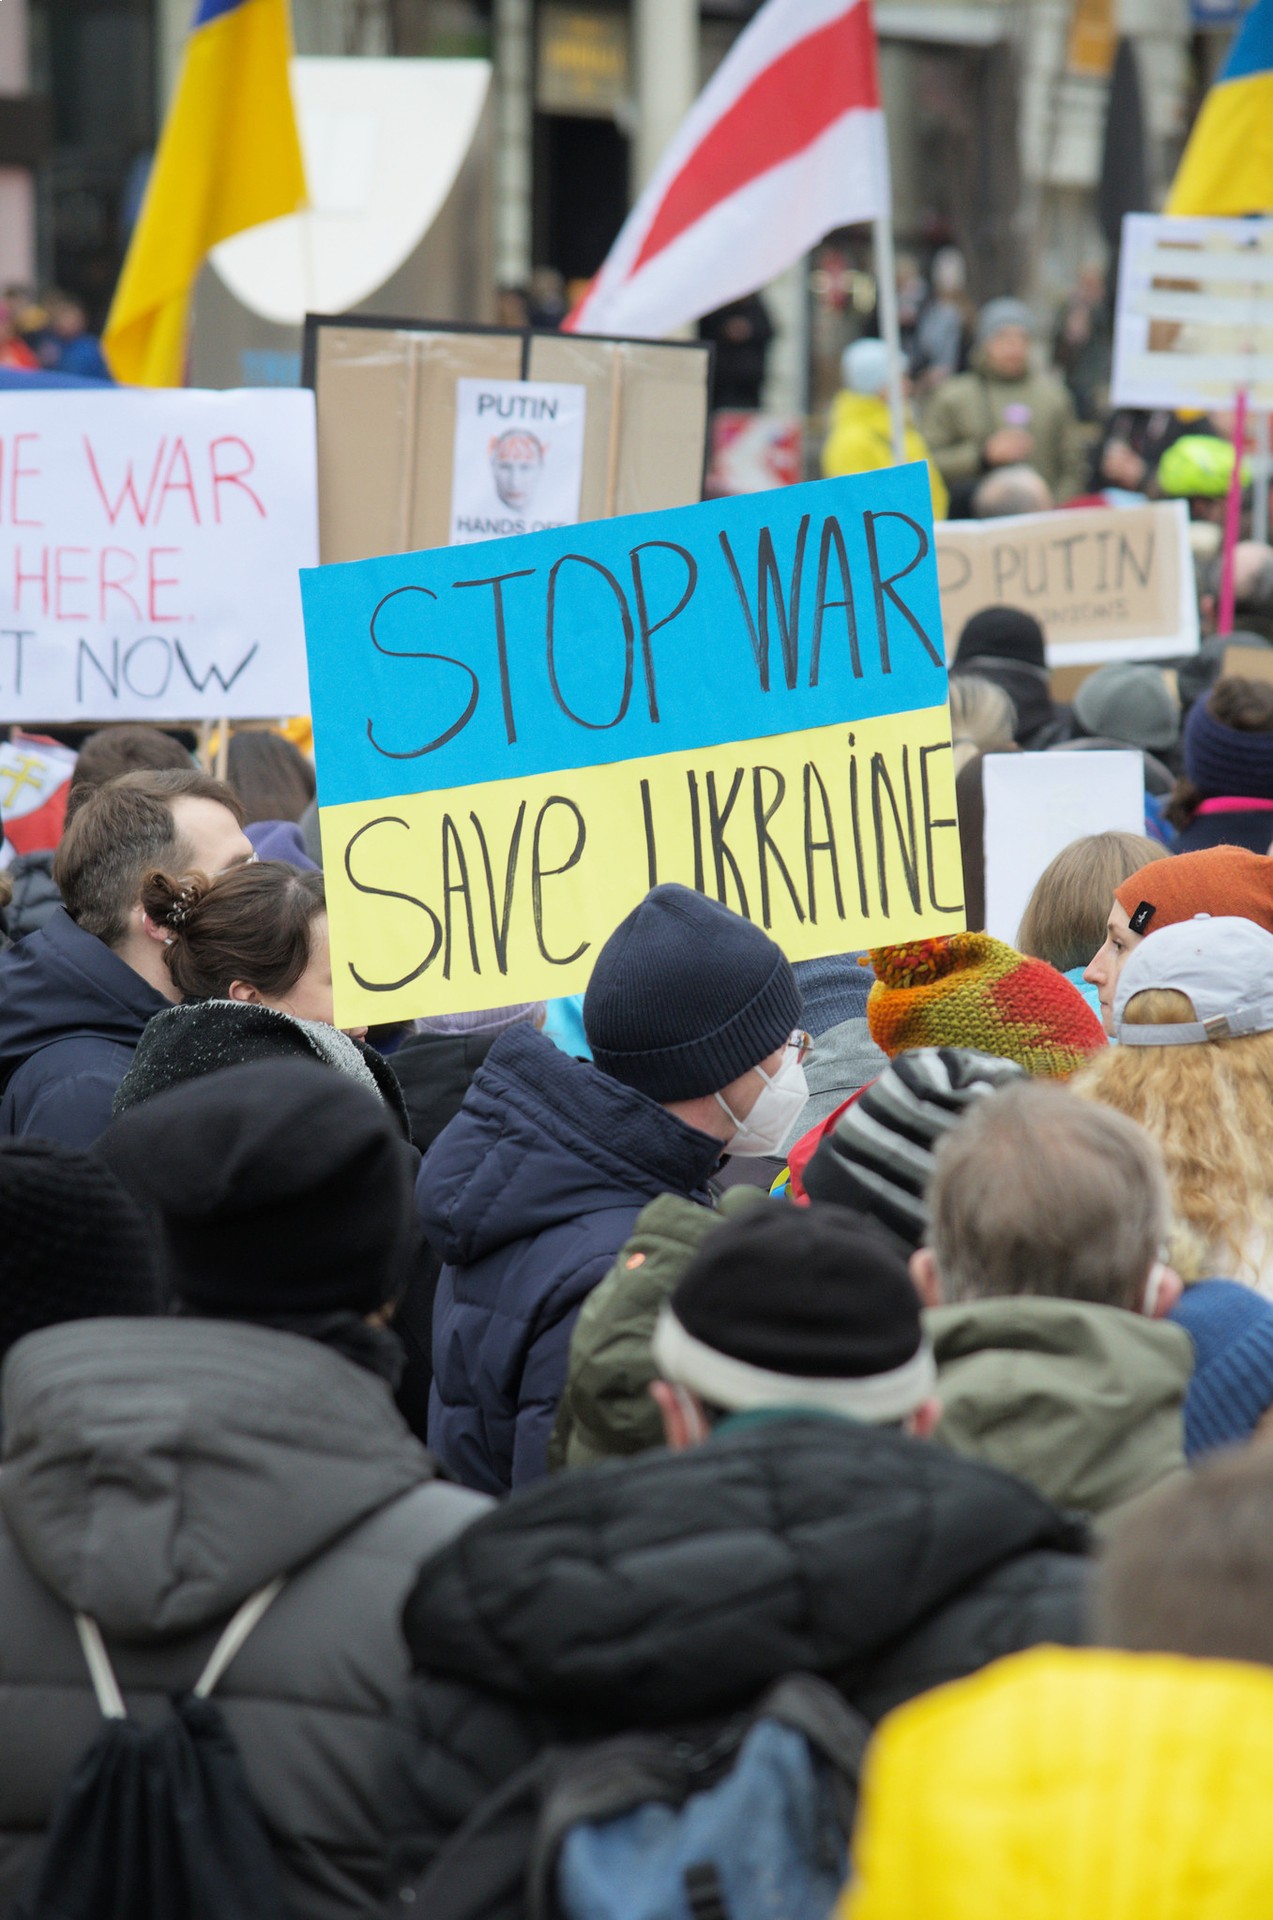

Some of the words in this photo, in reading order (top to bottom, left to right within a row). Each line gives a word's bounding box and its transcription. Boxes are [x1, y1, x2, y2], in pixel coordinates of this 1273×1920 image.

[477, 392, 559, 420] PUTIN
[83, 433, 267, 527] WAR
[456, 514, 527, 535] HANDS
[992, 527, 1155, 600] PUTIN
[75, 635, 260, 704] NOW
[367, 540, 698, 760] STOP
[718, 510, 945, 693] WAR
